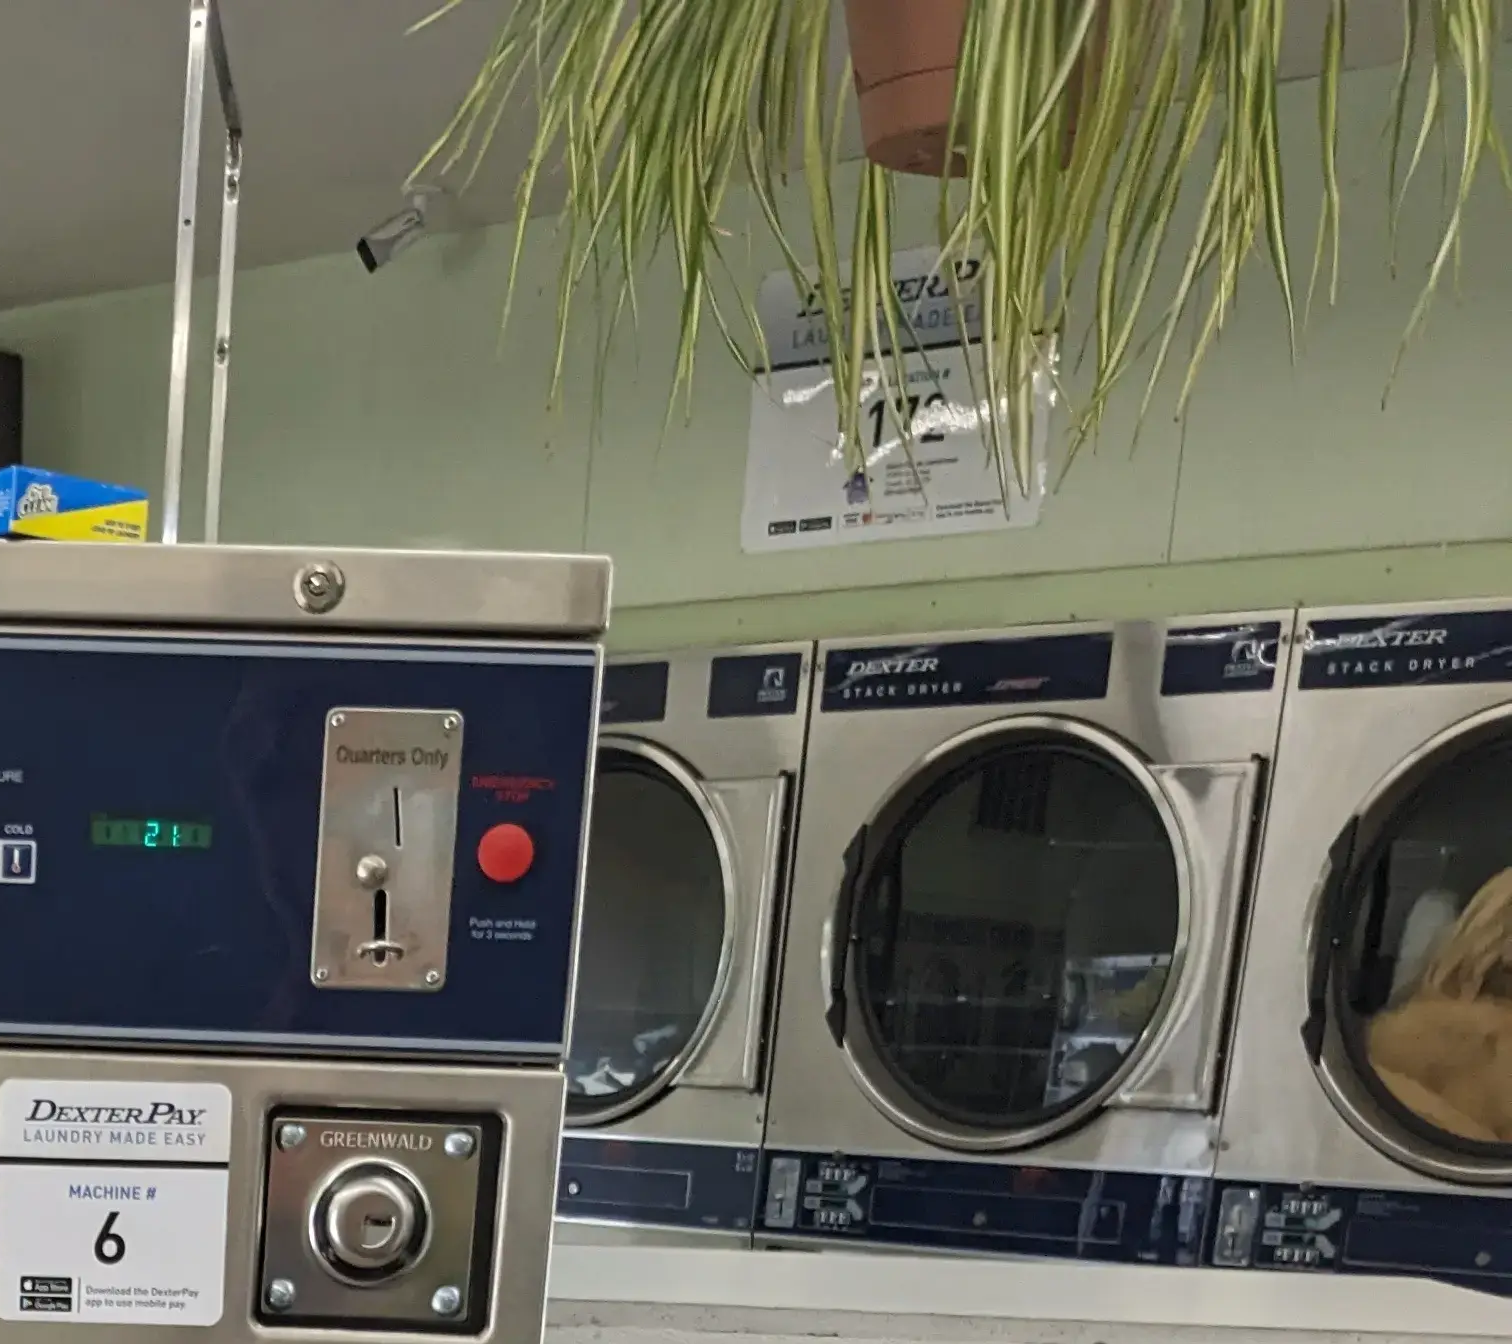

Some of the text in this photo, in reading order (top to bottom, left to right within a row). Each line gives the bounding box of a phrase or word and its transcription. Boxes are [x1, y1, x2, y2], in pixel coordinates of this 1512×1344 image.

[846, 656, 939, 676] DEXTER
[1327, 656, 1476, 676] STACK DRYER
[843, 682, 963, 700] STACK DRYER
[336, 744, 449, 771] Quarters Only
[3, 824, 34, 836] COLD
[23, 1127, 207, 1147] LAUNDRY MADE EASY
[320, 1130, 433, 1151] GREENWALD
[68, 1184, 157, 1201] MACHINE #
[94, 1211, 126, 1265] 6
[86, 1284, 200, 1299] Download the DexterPay
[85, 1299, 103, 1309] app
[104, 1297, 113, 1307] to
[135, 1298, 167, 1309] mobile
